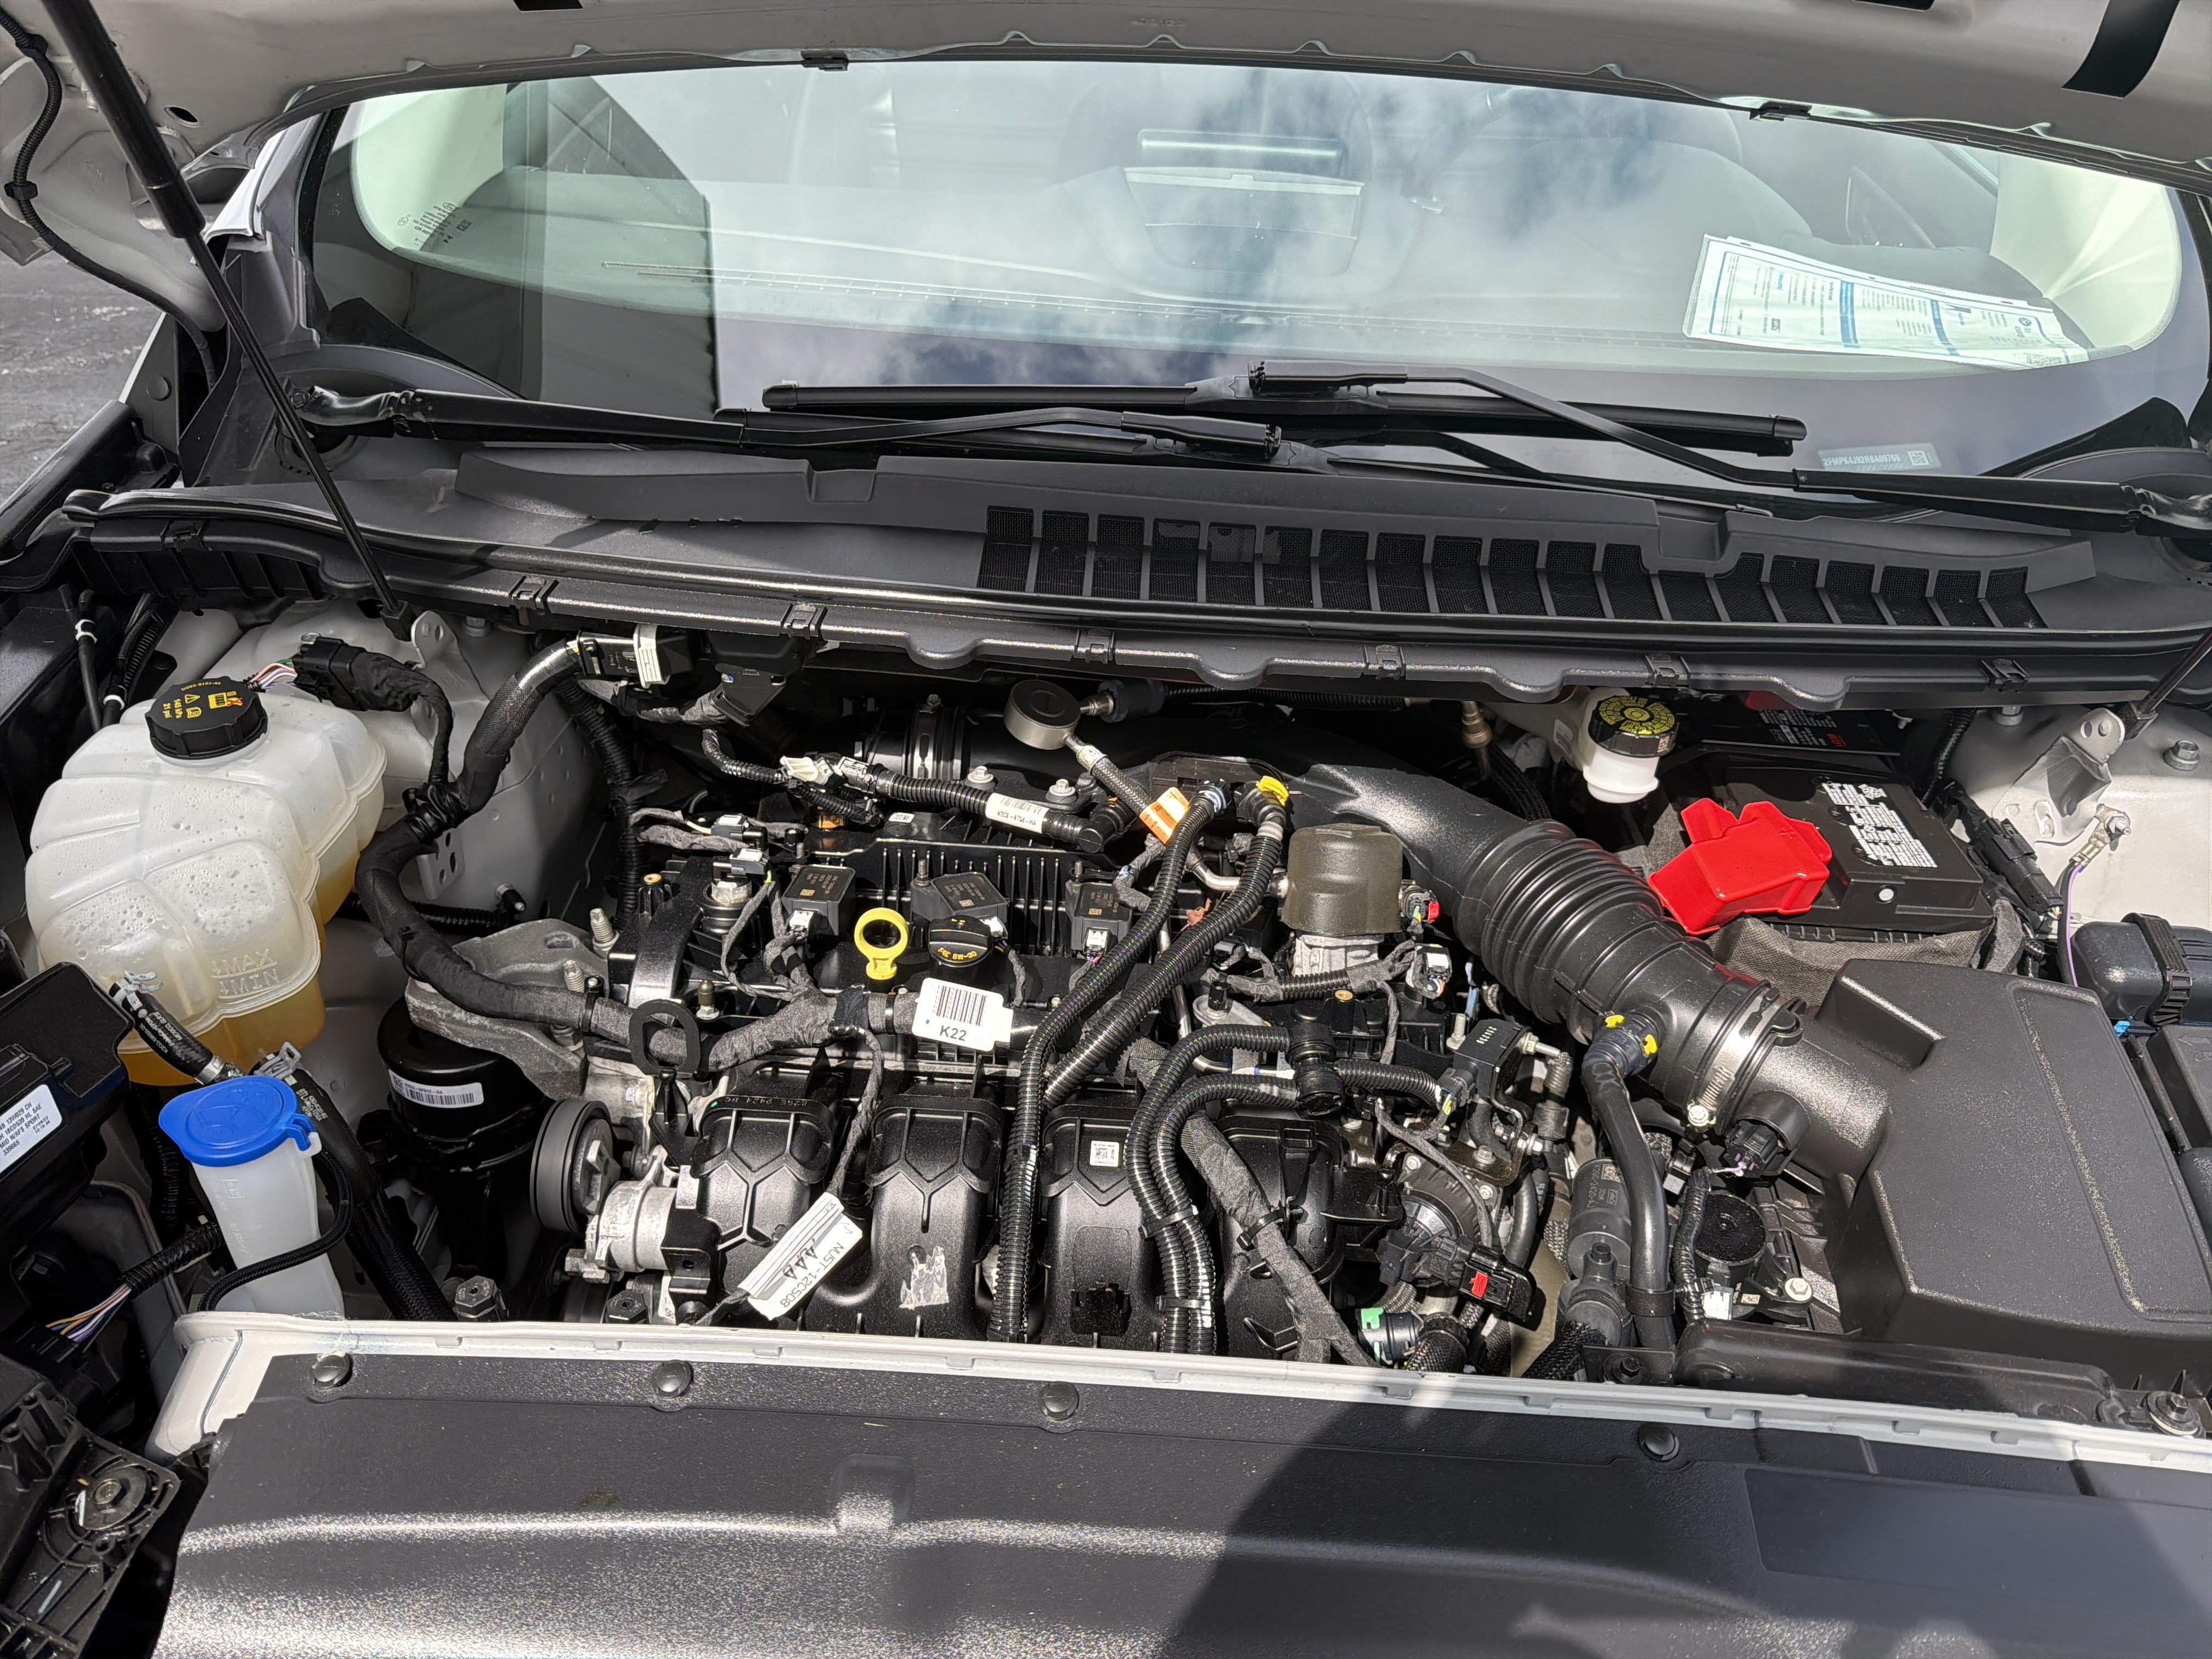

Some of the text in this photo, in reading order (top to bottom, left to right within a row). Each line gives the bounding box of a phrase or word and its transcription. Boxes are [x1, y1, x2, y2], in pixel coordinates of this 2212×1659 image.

[222, 948, 274, 974] MAX
[937, 947, 977, 960] SAE 5W-30
[230, 968, 280, 995] MIN
[939, 1025, 967, 1041] K22
[25, 1102, 33, 1110] CH
[25, 1111, 33, 1121] HL
[32, 1103, 42, 1114] SAE
[9, 1126, 25, 1141] N/AFS
[25, 1113, 40, 1129] SPORT
